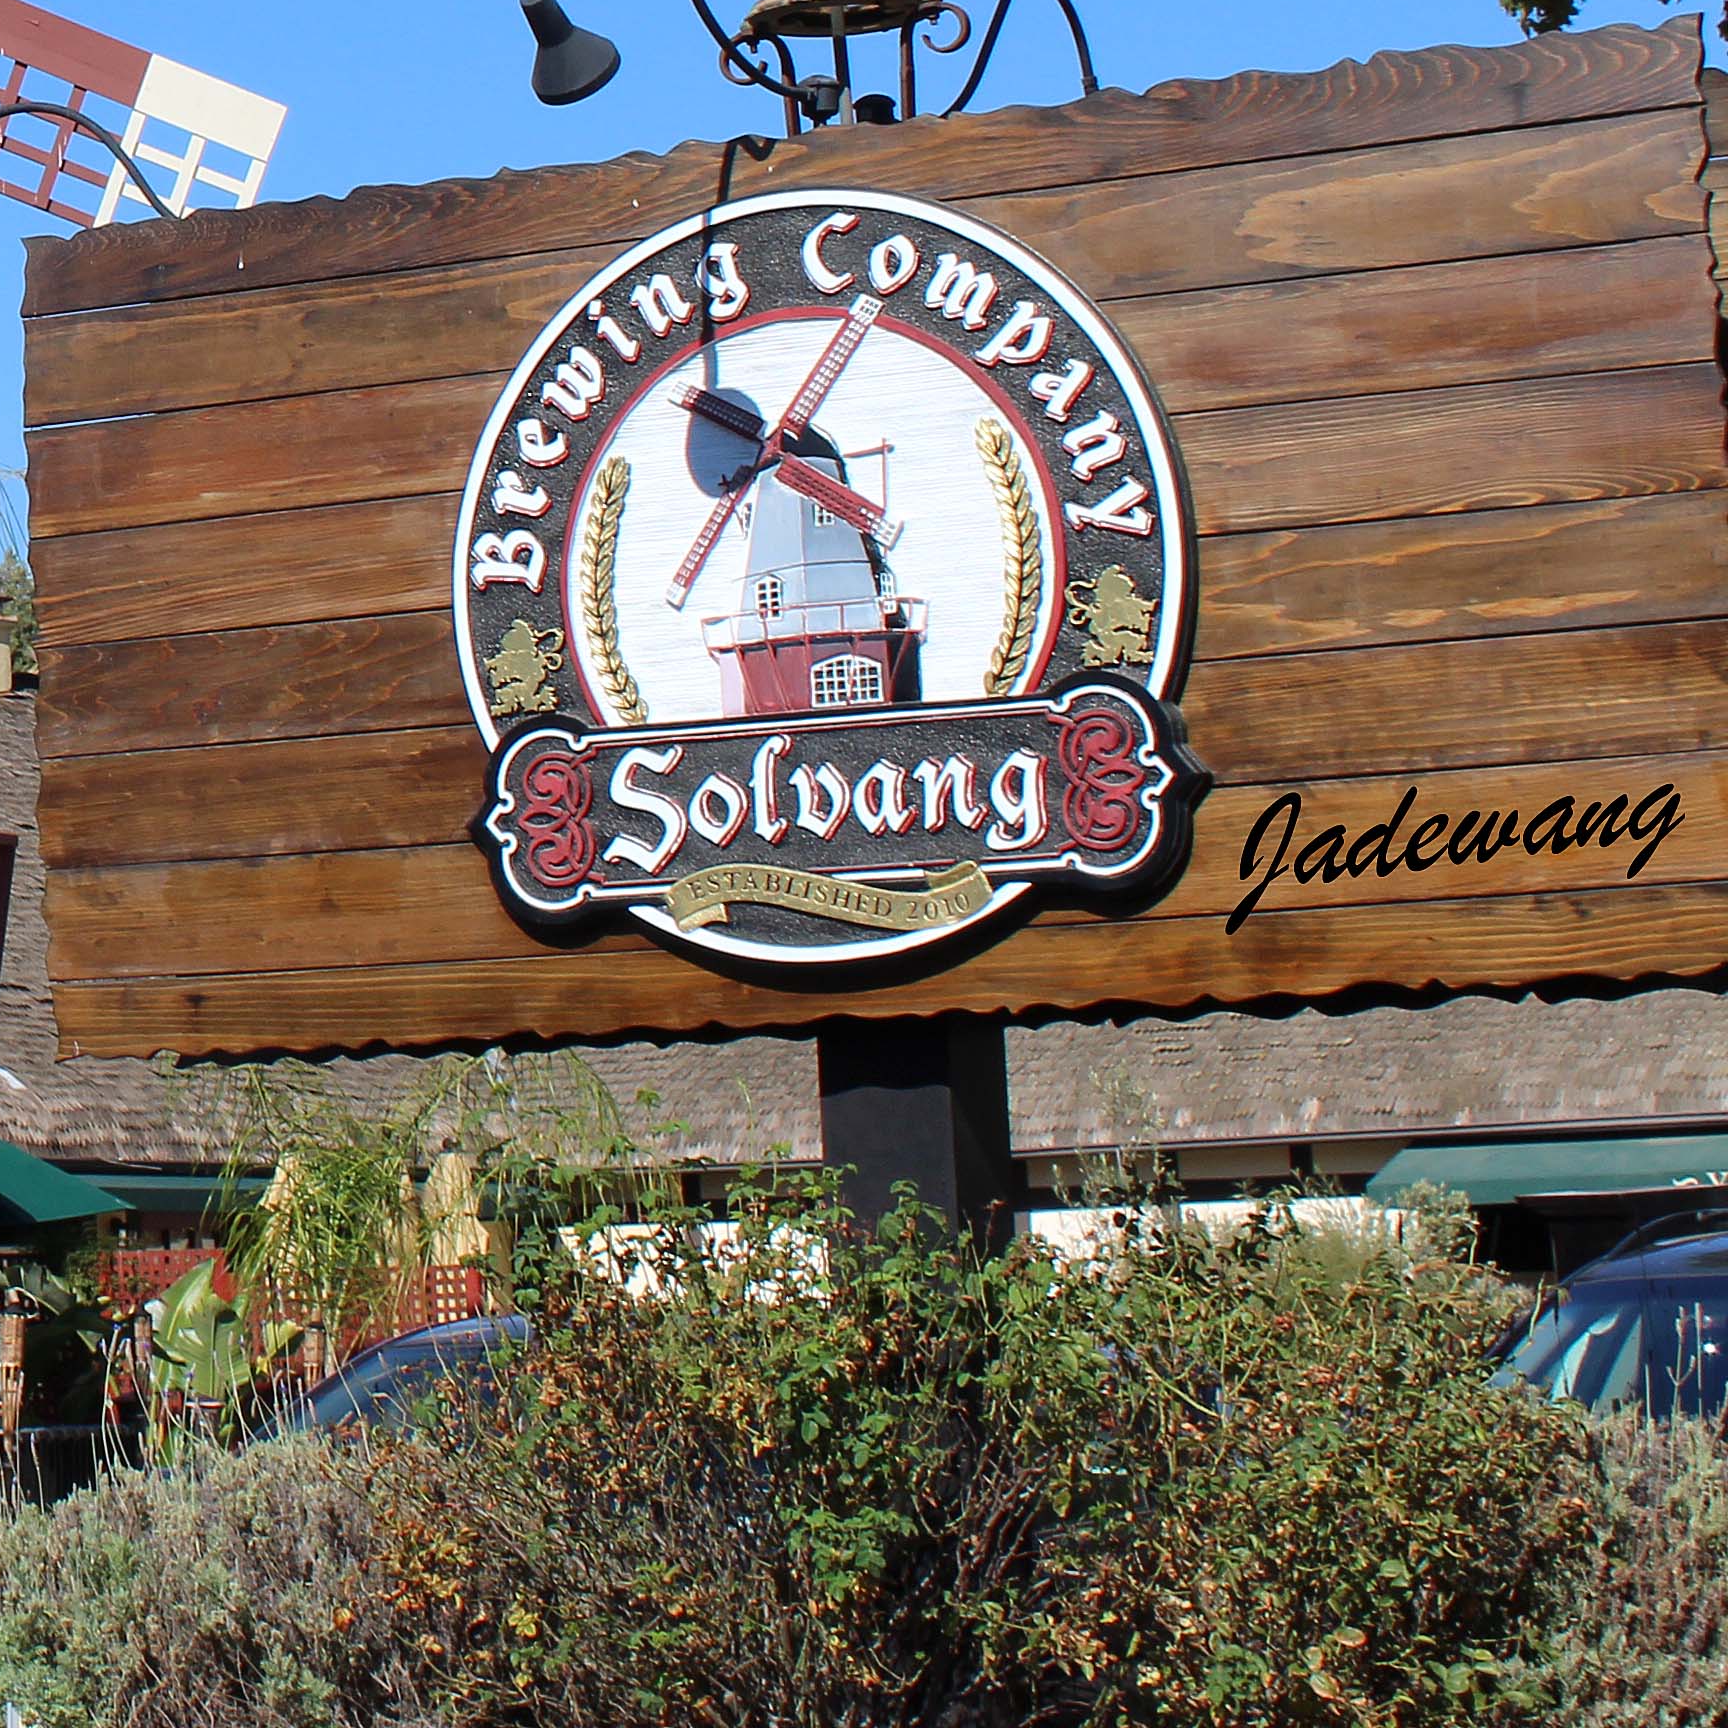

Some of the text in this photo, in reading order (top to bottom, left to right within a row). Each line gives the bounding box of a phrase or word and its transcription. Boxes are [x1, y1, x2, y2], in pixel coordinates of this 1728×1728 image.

[468, 210, 1154, 594] Brewing Company
[601, 731, 1052, 875] Solvang
[685, 871, 971, 922] ESTABLISHED 2010
